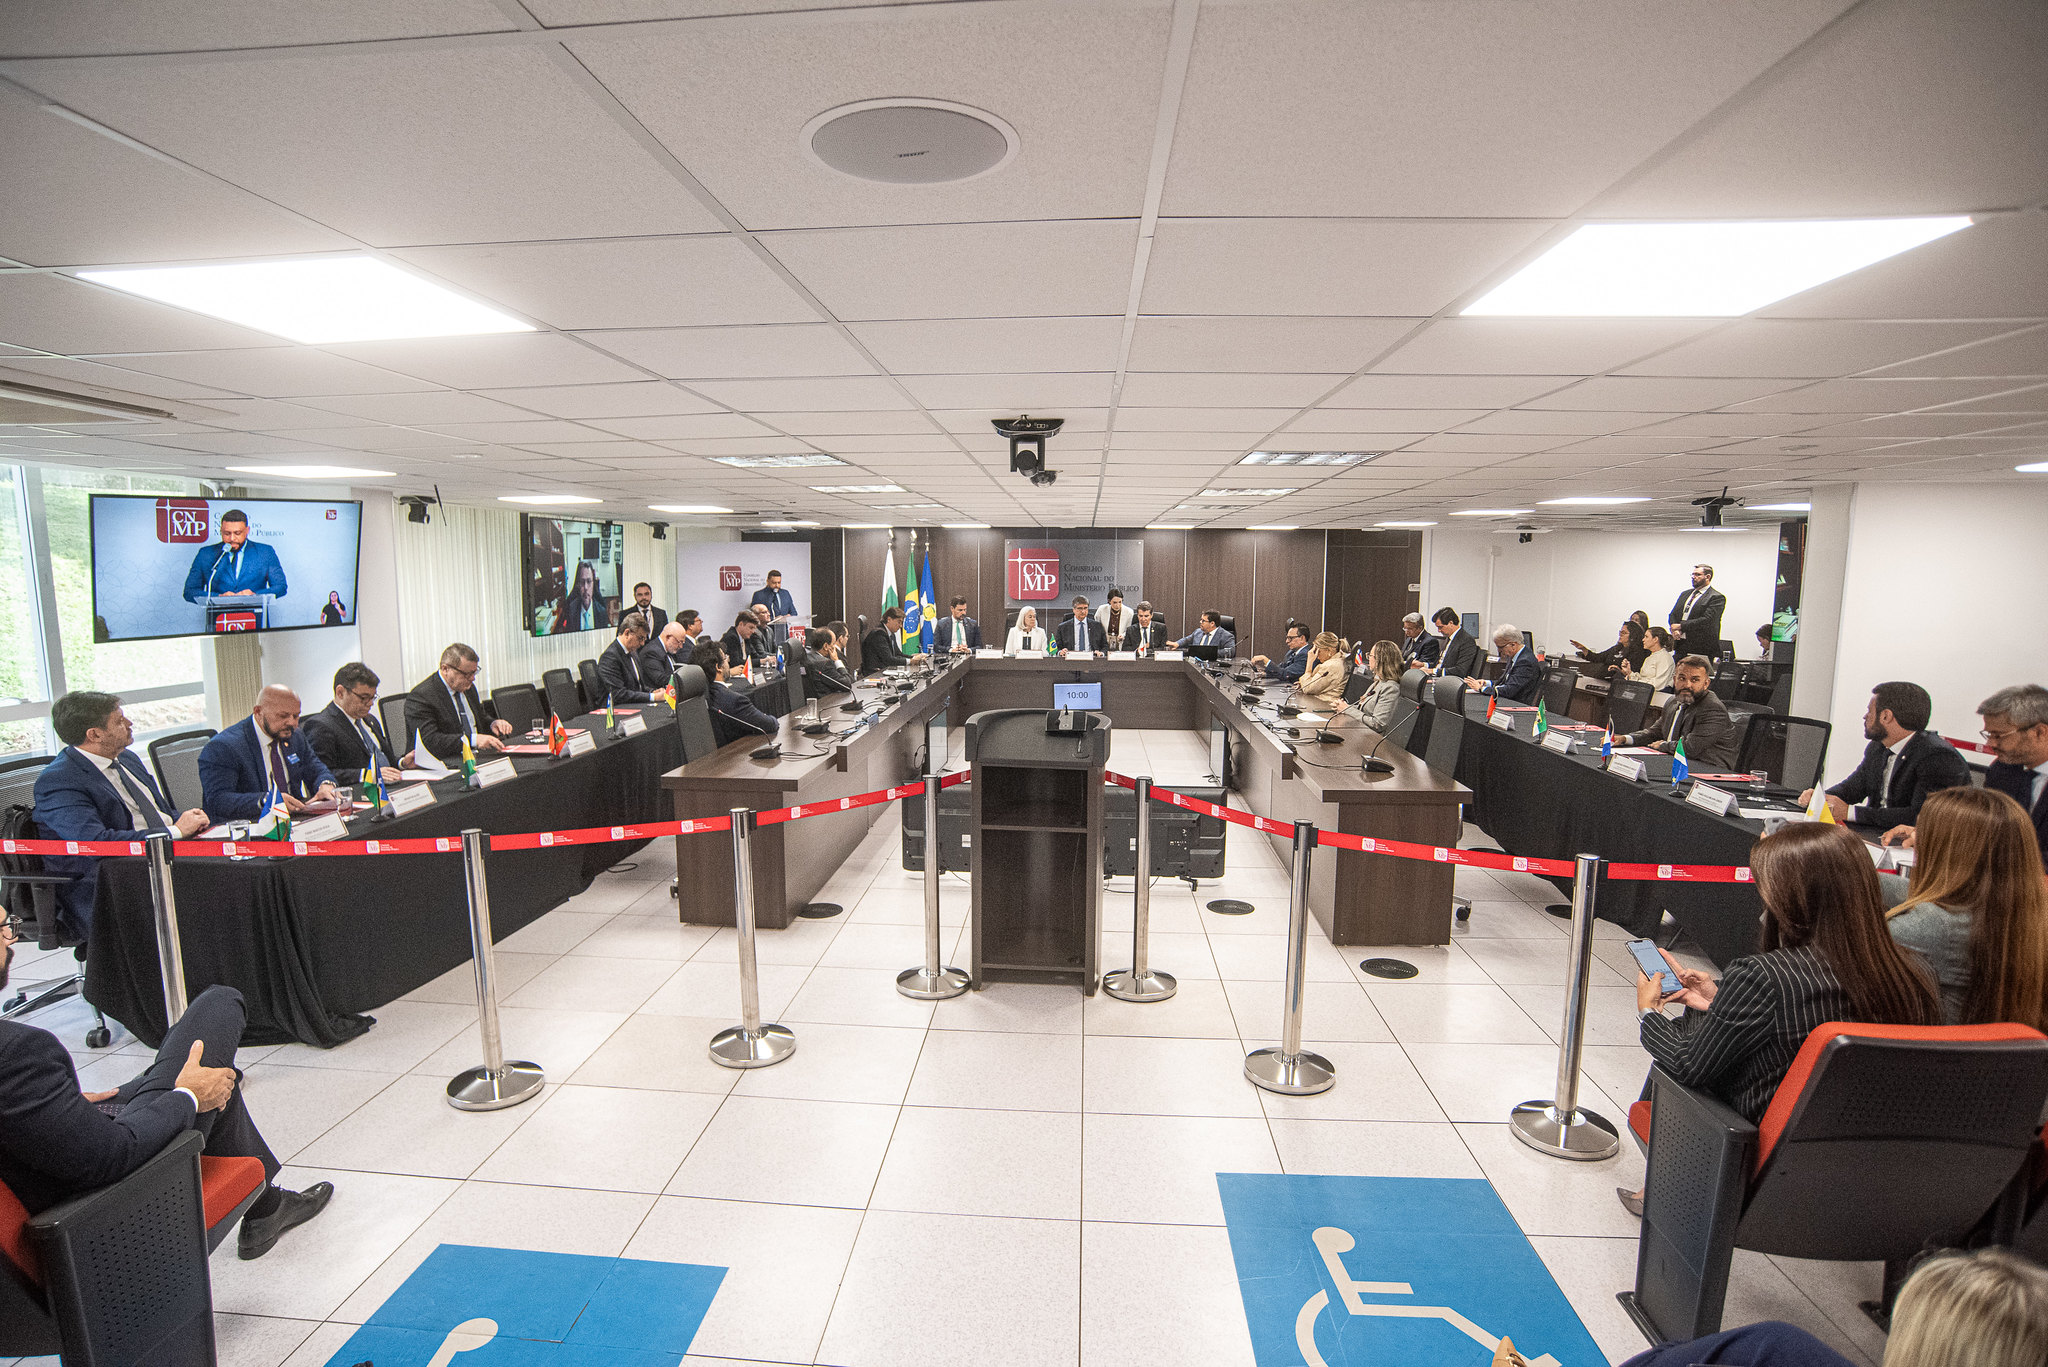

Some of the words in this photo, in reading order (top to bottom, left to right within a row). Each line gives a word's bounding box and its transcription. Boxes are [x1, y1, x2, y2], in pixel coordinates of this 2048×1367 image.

[172, 511, 197, 523] CN
[172, 521, 206, 537] MP
[1023, 562, 1046, 577] CN
[726, 579, 740, 587] MP
[1022, 574, 1056, 591] MP
[227, 622, 246, 631] CN
[1067, 691, 1088, 699] 10:00
